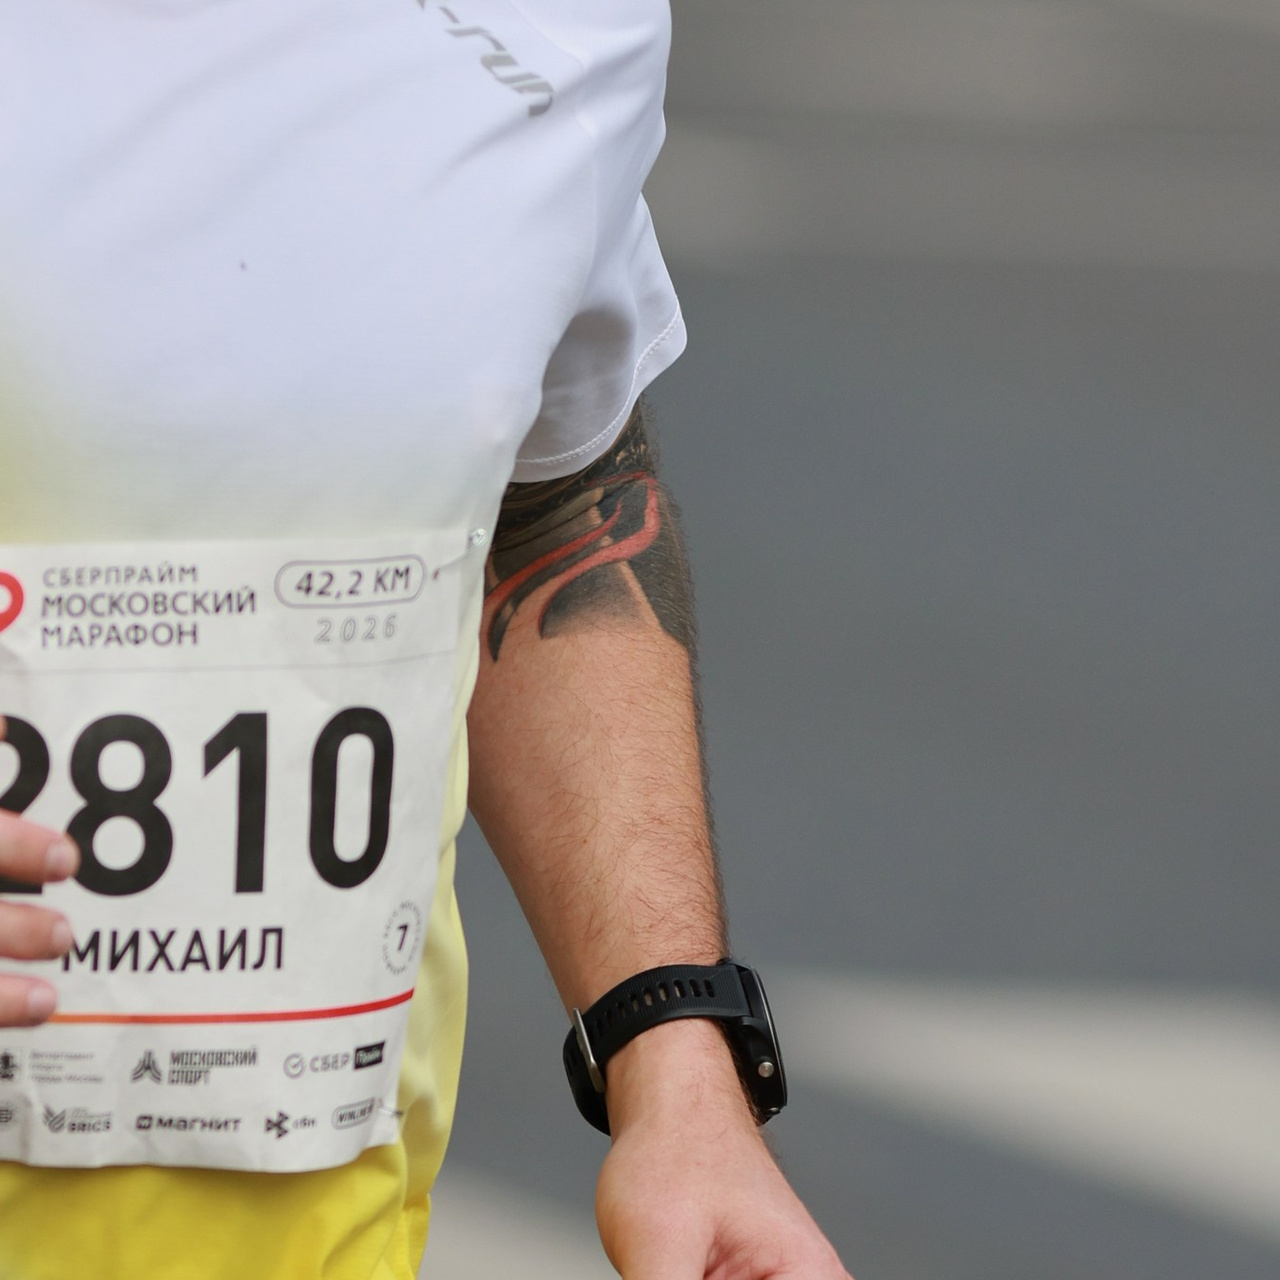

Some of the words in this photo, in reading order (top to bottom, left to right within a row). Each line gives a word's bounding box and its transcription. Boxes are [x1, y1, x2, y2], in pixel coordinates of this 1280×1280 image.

[42, 561, 198, 588] СБЕРПРАЙМ
[295, 570, 362, 598] 42,2
[41, 586, 256, 618] МОСКОВСКИЙ
[42, 622, 198, 648] МАРАФОН
[314, 613, 397, 643] 2026
[62, 927, 283, 972] МИХАИЛ
[397, 923, 408, 951] 7
[170, 1045, 258, 1067] МОСКОВСКИЙ
[309, 1052, 350, 1073] СБЕР
[169, 1069, 211, 1086] СПОРТ
